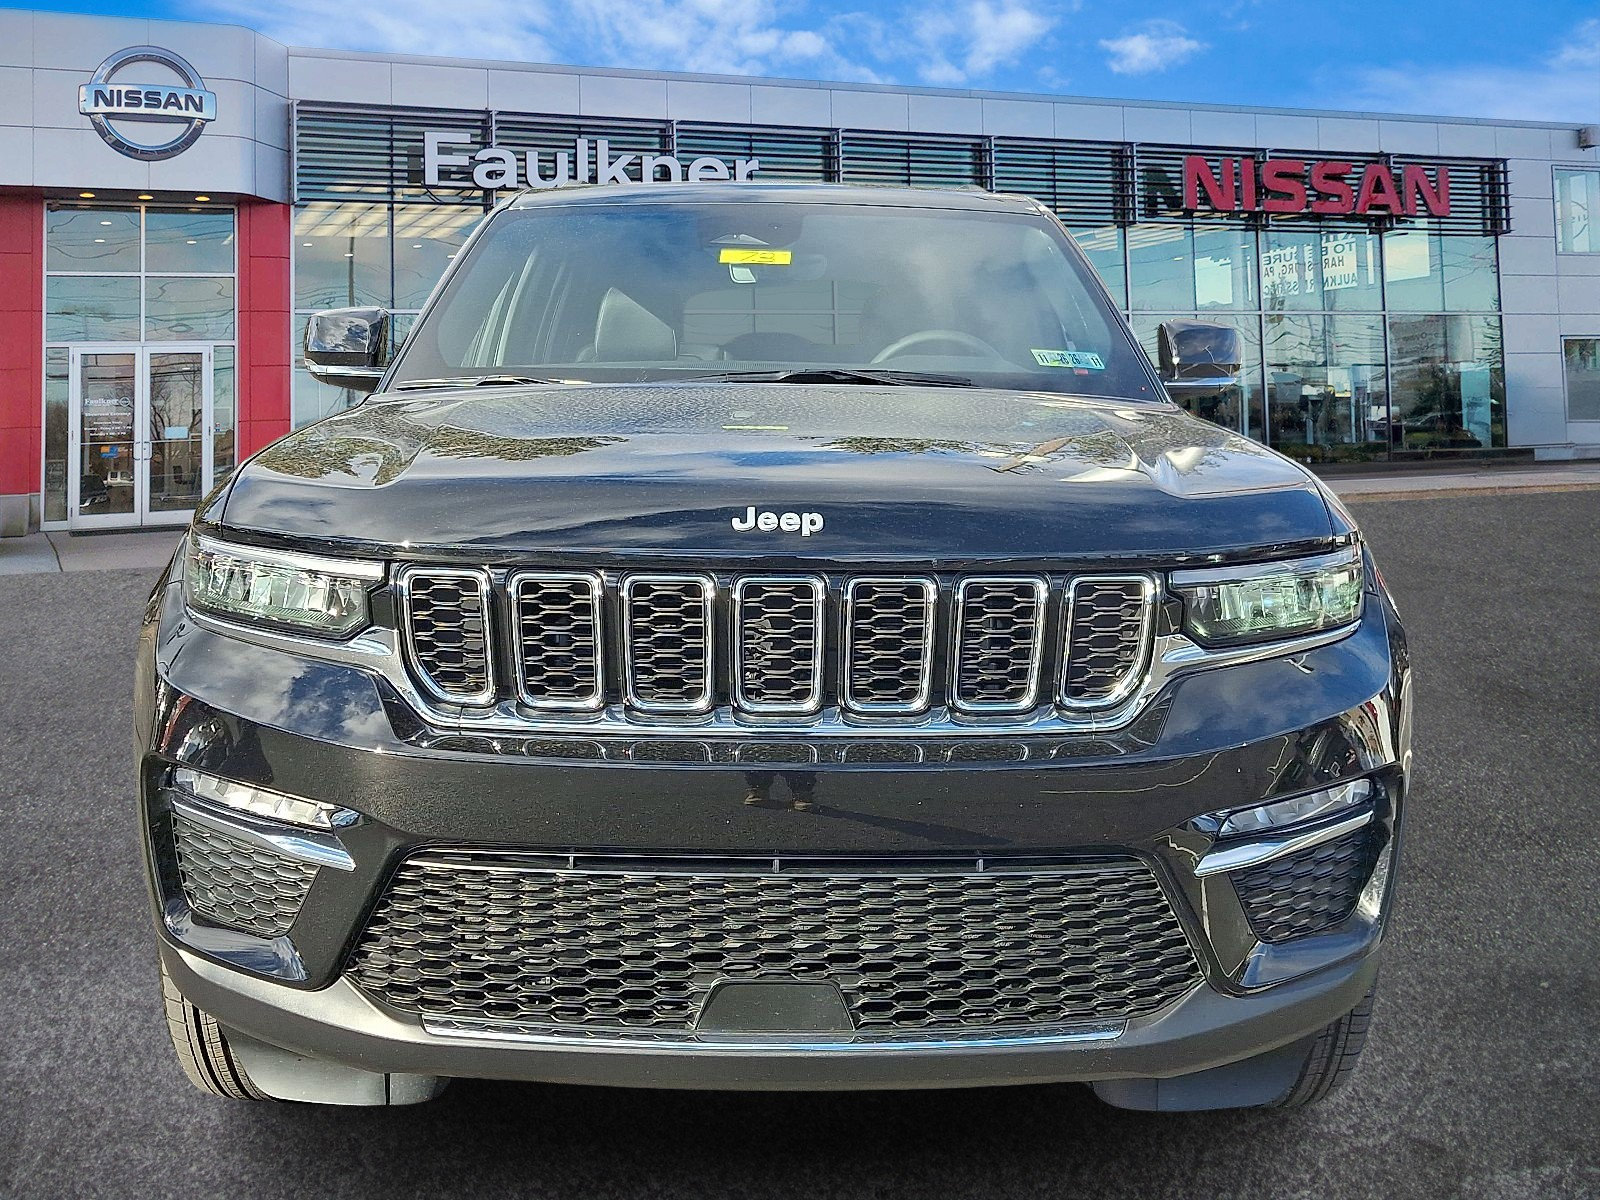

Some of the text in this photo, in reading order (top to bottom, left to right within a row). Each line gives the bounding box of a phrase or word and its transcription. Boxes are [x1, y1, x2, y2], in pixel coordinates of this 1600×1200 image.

[93, 89, 203, 113] NISSAN
[423, 131, 759, 189] Faulkner
[1184, 155, 1451, 217] NISSAN
[731, 506, 824, 537] Jeep
